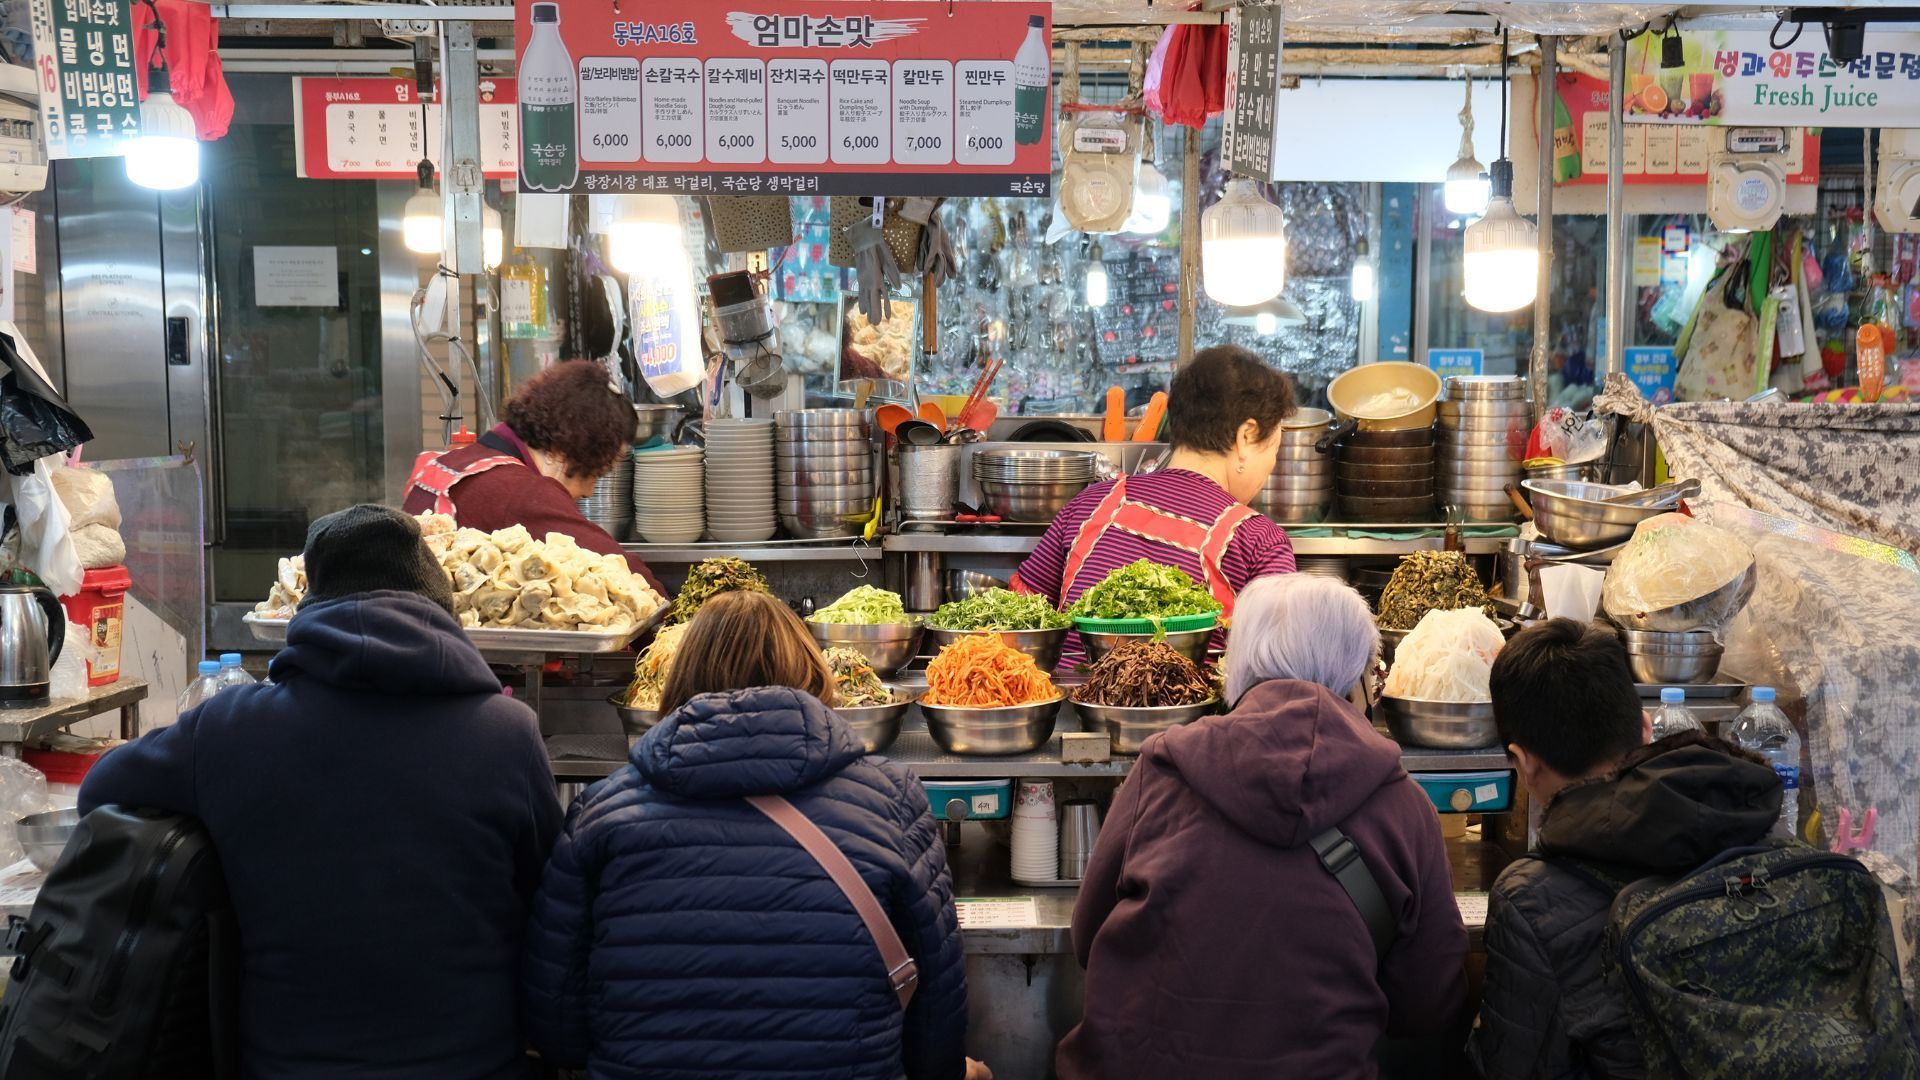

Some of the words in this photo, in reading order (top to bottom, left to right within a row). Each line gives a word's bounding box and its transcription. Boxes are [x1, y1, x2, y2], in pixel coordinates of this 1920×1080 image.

[613, 22, 697, 46] 동부A16호
[753, 15, 875, 48] 엄마손맛
[1249, 17, 1273, 45] 엄마손맛
[580, 67, 639, 80] 쌀/보리비빔밥
[645, 68, 700, 83] 손칼국수
[708, 68, 762, 84] 칼수제비
[770, 69, 826, 84] 잔치국수
[833, 69, 888, 85] 떡만두국
[903, 70, 944, 85] 칼만두
[965, 70, 1006, 86] 찐만두
[63, 71, 135, 107] 비빔냉면
[1754, 83, 1814, 106] Fresh
[1819, 84, 1879, 113] Juice
[1238, 92, 1273, 132] 칼수제비
[592, 134, 629, 149] 6,000
[656, 134, 692, 149] 6,000
[718, 135, 755, 150] 6,000
[781, 135, 817, 151] 5,000
[843, 136, 879, 151] 6,000
[906, 136, 942, 152] 7,000
[968, 136, 1003, 152] 6,000
[530, 143, 567, 158] 국순당
[1234, 131, 1270, 174] 보리비빔밥
[583, 175, 637, 190] 광장시장
[642, 175, 669, 190] 대표
[674, 175, 717, 192] 막걸리,
[722, 175, 763, 191] 국순당
[767, 176, 819, 191] 생막걸리
[1010, 180, 1046, 194] 국순당
